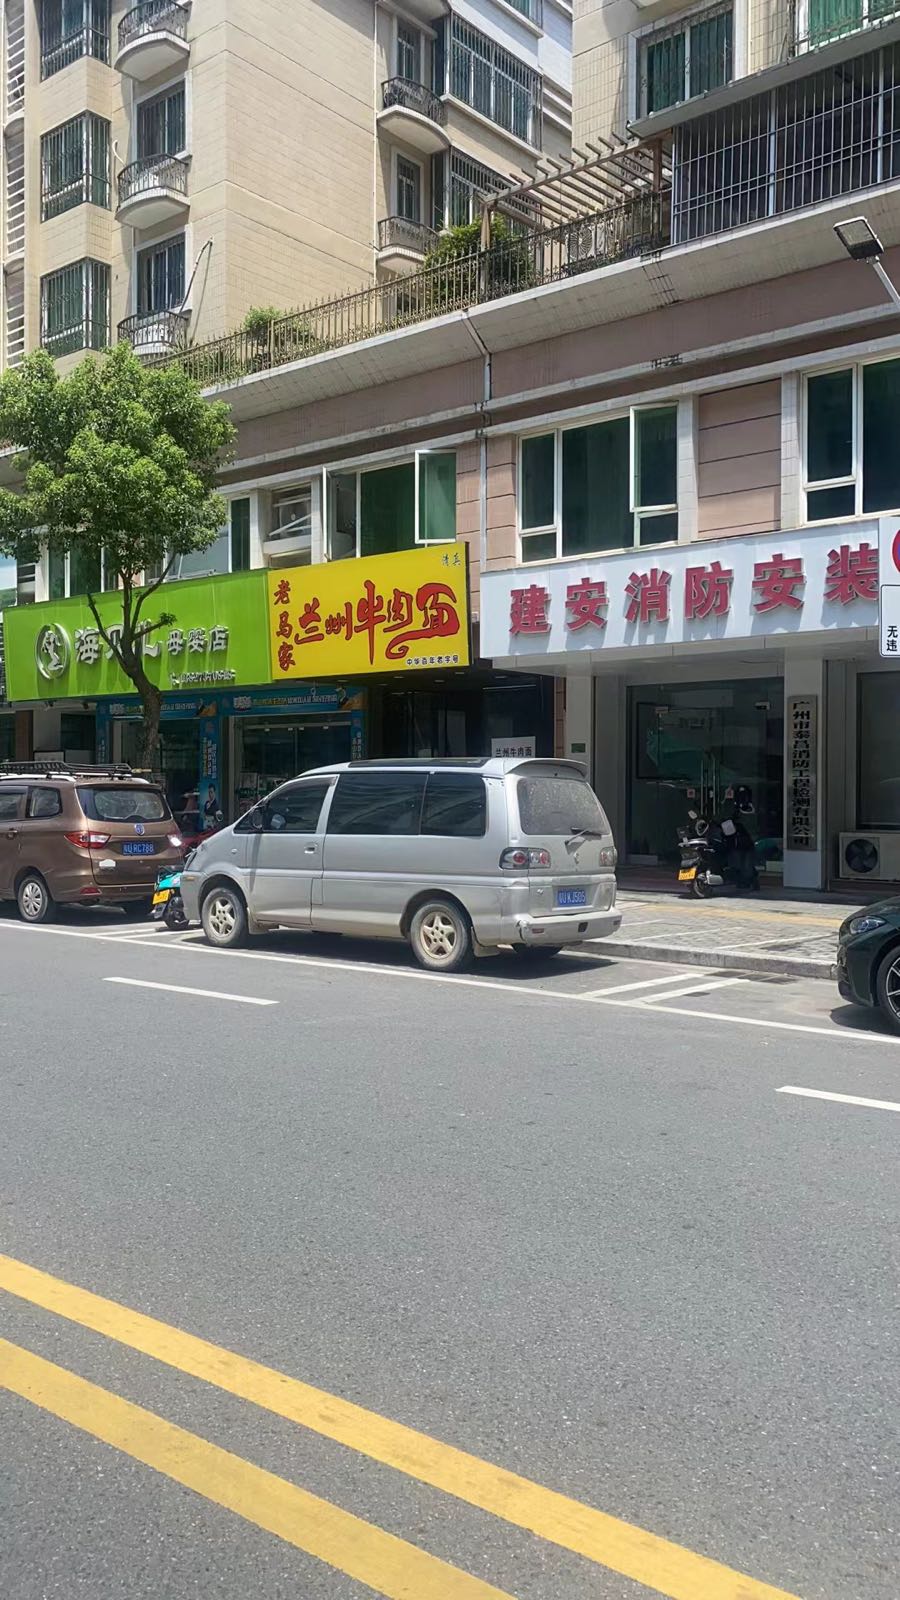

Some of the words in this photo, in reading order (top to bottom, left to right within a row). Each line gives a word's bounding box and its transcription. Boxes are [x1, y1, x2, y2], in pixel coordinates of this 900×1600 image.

[273, 579, 296, 671] 老马家
[294, 579, 460, 665] 兰州牛肉面
[508, 541, 878, 636] 建安消防安装
[406, 654, 459, 666] 中华百年老字号
[495, 746, 532, 758] 兰州牛肉面
